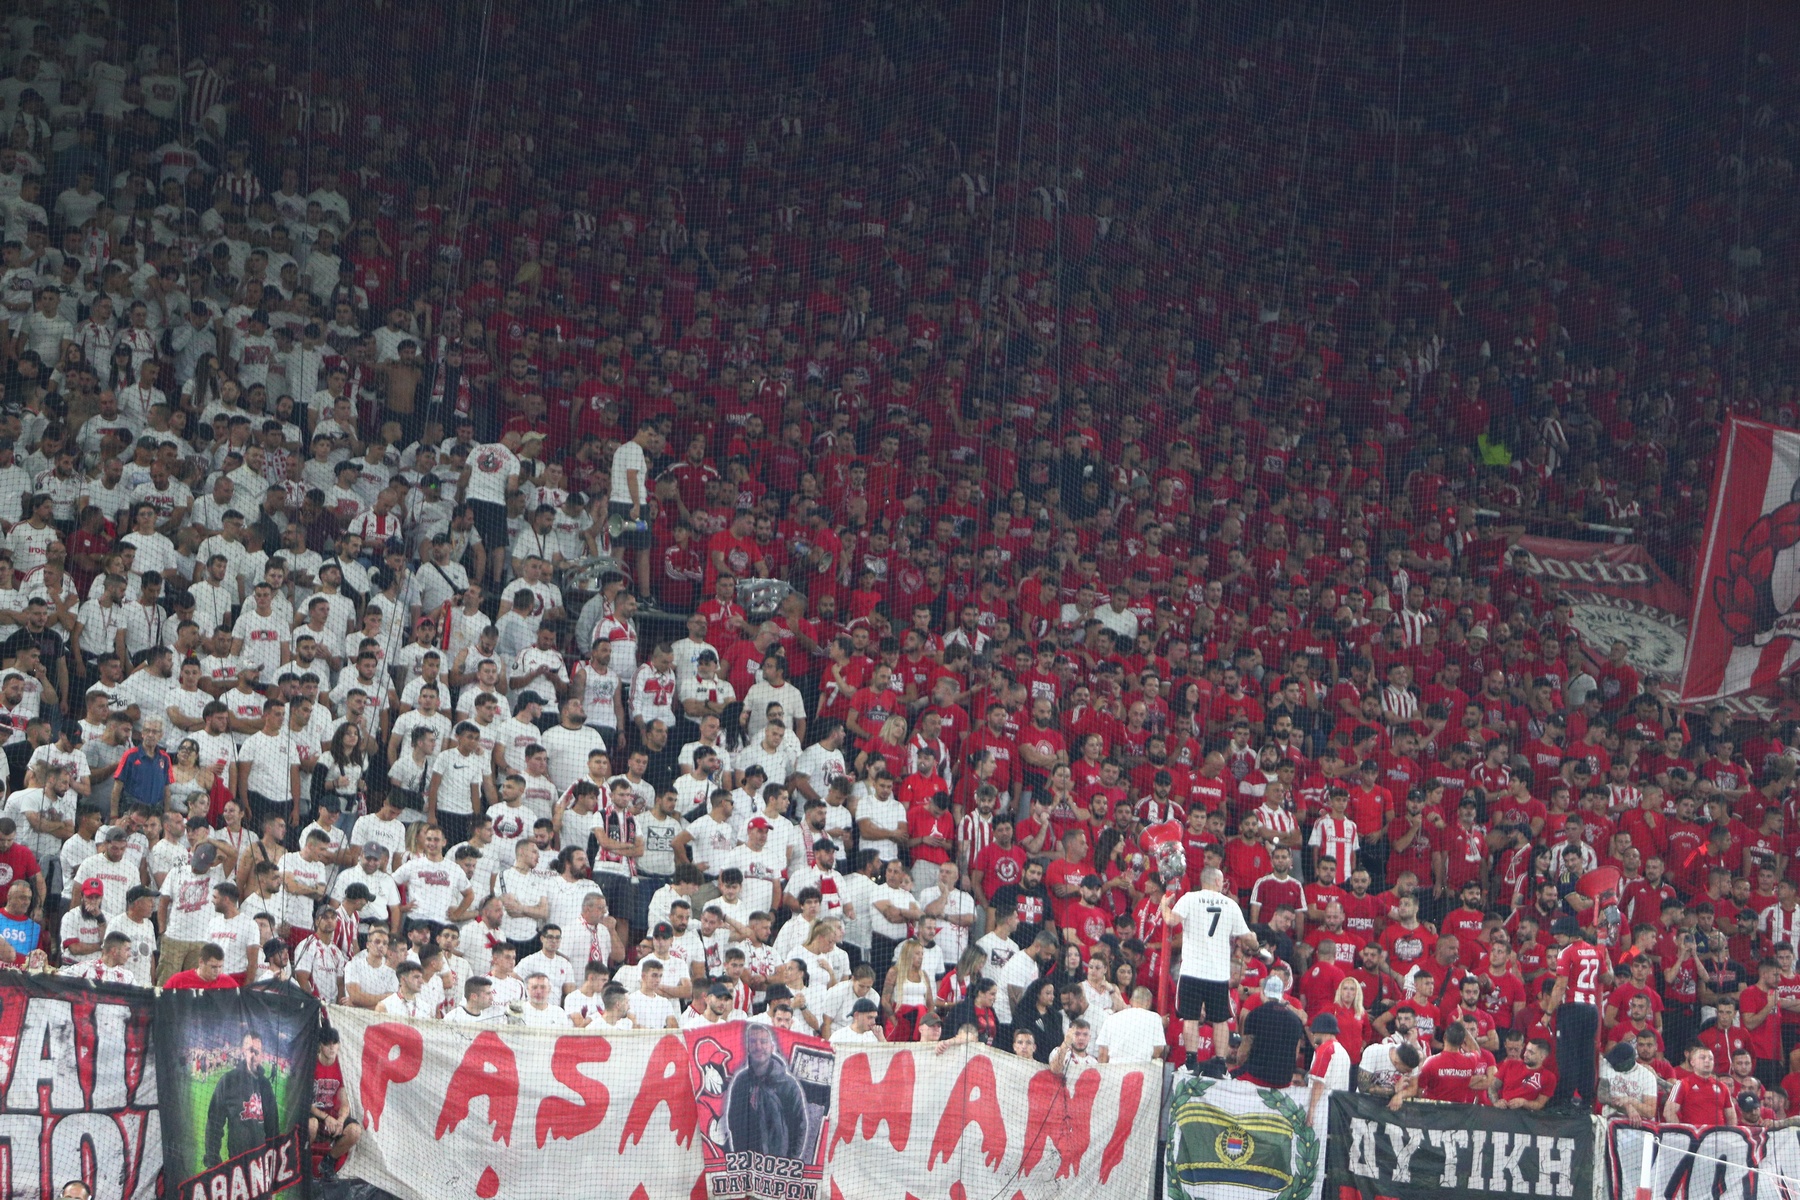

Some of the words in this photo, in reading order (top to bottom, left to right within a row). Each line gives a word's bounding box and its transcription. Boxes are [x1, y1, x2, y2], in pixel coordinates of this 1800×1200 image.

[2, 928, 26, 942] 650
[1206, 907, 1222, 937] 7
[1577, 959, 1599, 988] 22
[1348, 1117, 1575, 1197] ΔΥΤΙΚΗ
